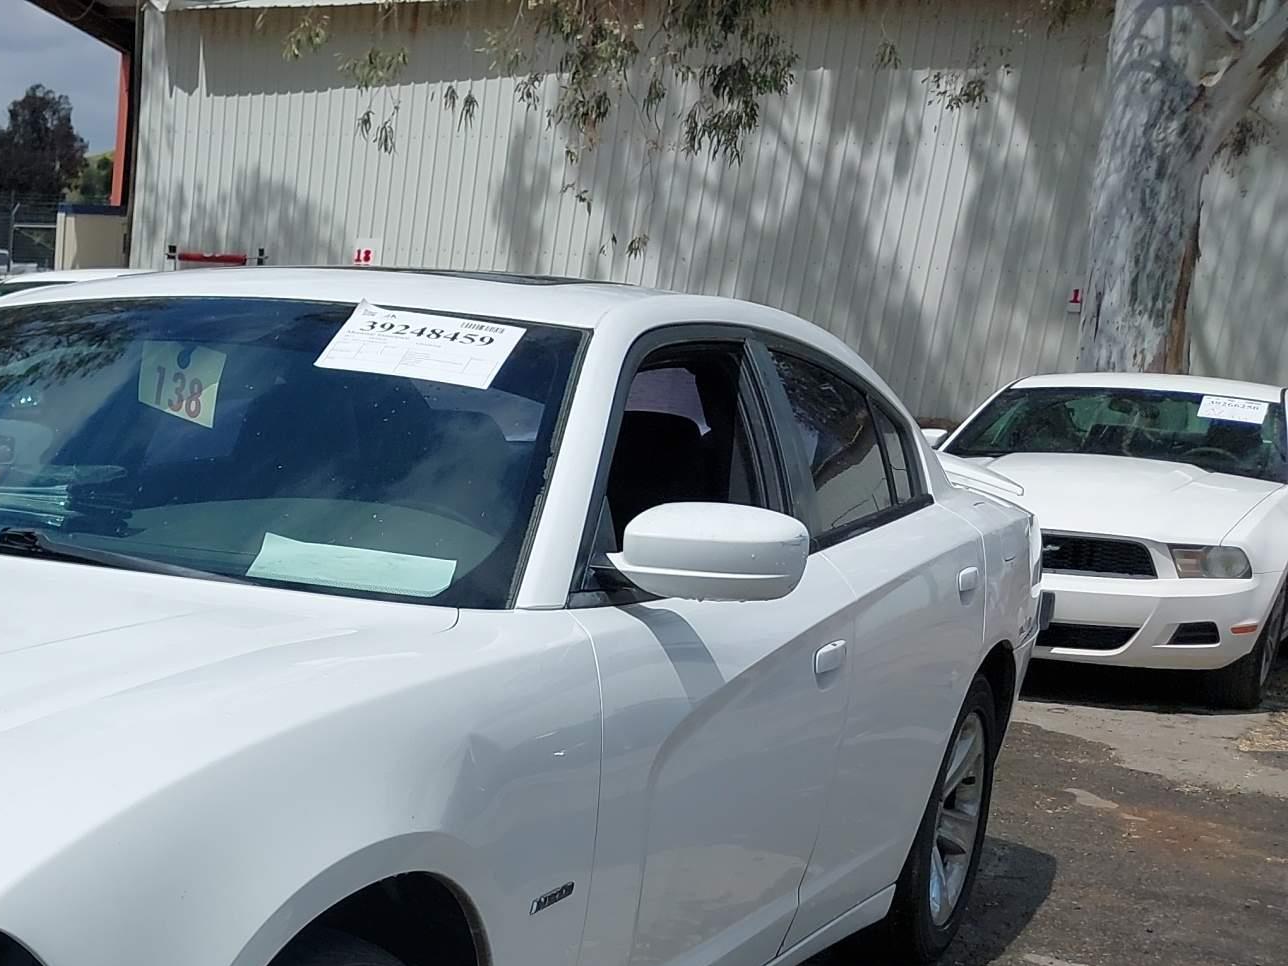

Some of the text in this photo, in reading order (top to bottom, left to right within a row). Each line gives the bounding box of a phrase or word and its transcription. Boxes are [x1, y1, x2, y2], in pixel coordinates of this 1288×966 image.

[354, 248, 372, 263] 18
[359, 320, 495, 348] 39248459
[153, 365, 204, 419] 138
